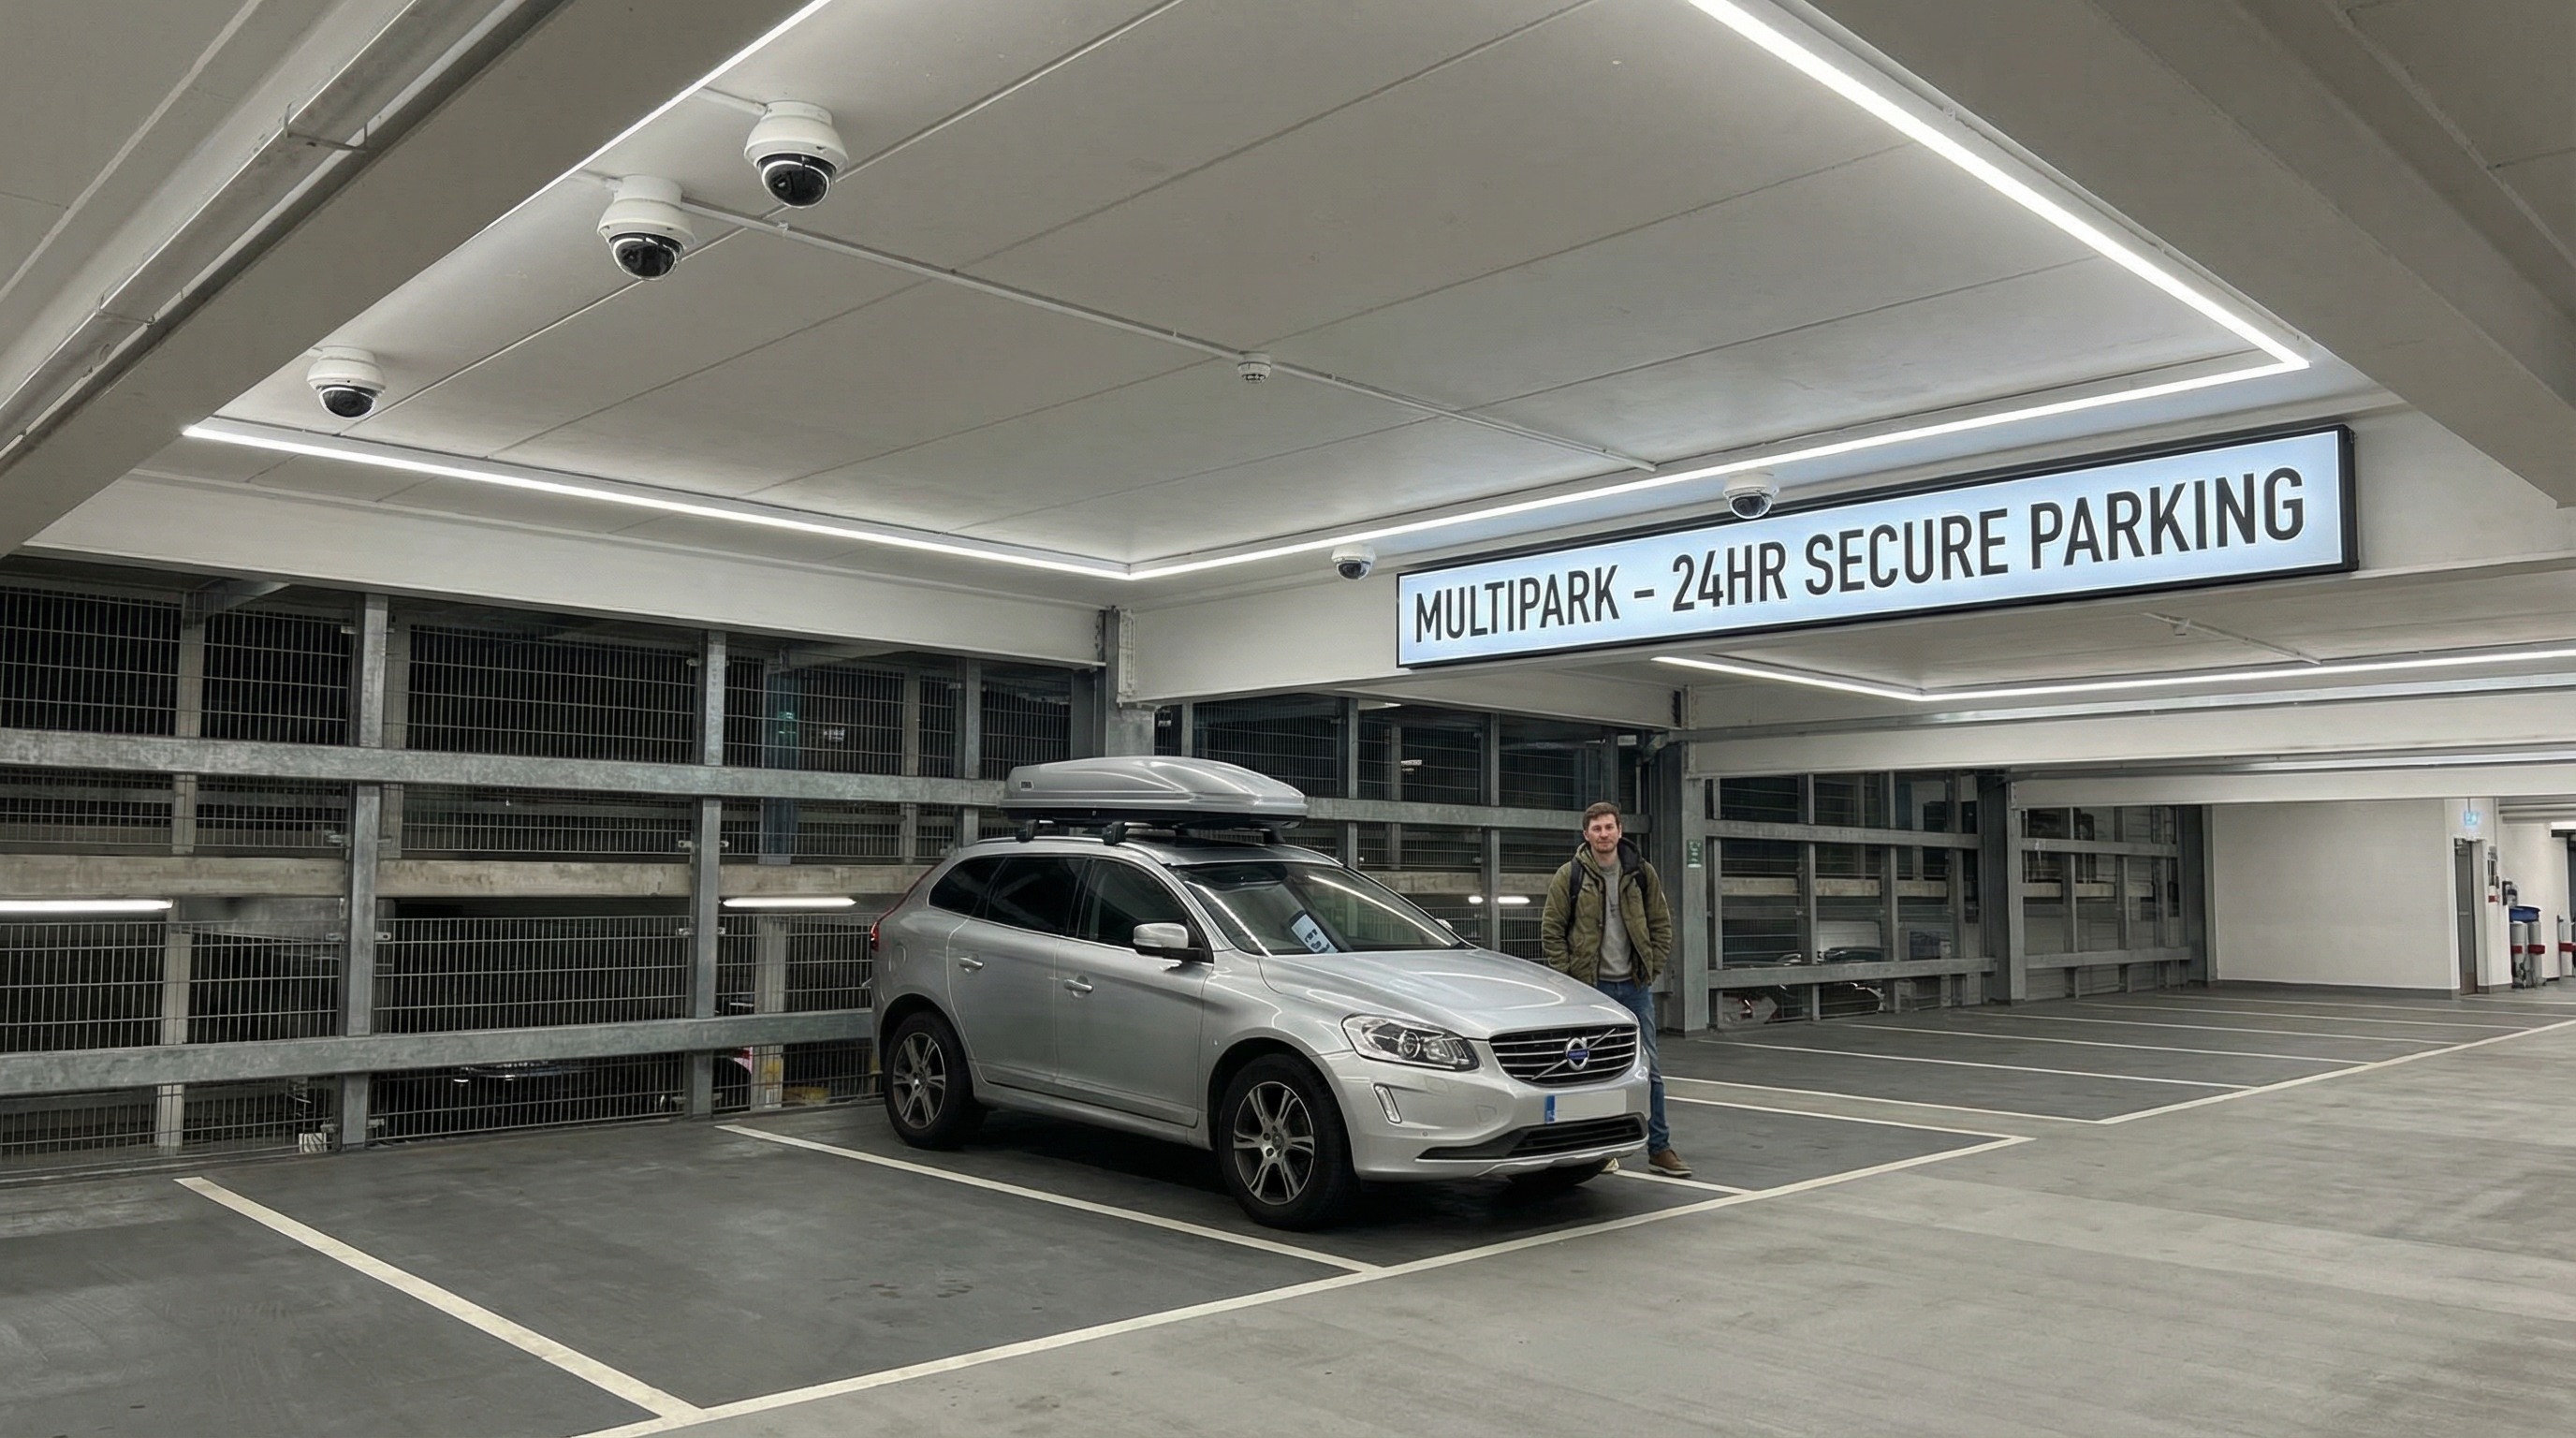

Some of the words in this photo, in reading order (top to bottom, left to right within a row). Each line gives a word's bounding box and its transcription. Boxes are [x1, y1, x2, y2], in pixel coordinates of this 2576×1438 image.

[1415, 565, 1620, 643] MULTIPARK
[1673, 541, 1788, 612] 24HR
[1805, 507, 2009, 595] SECURE
[2030, 467, 2304, 570] PARKING
